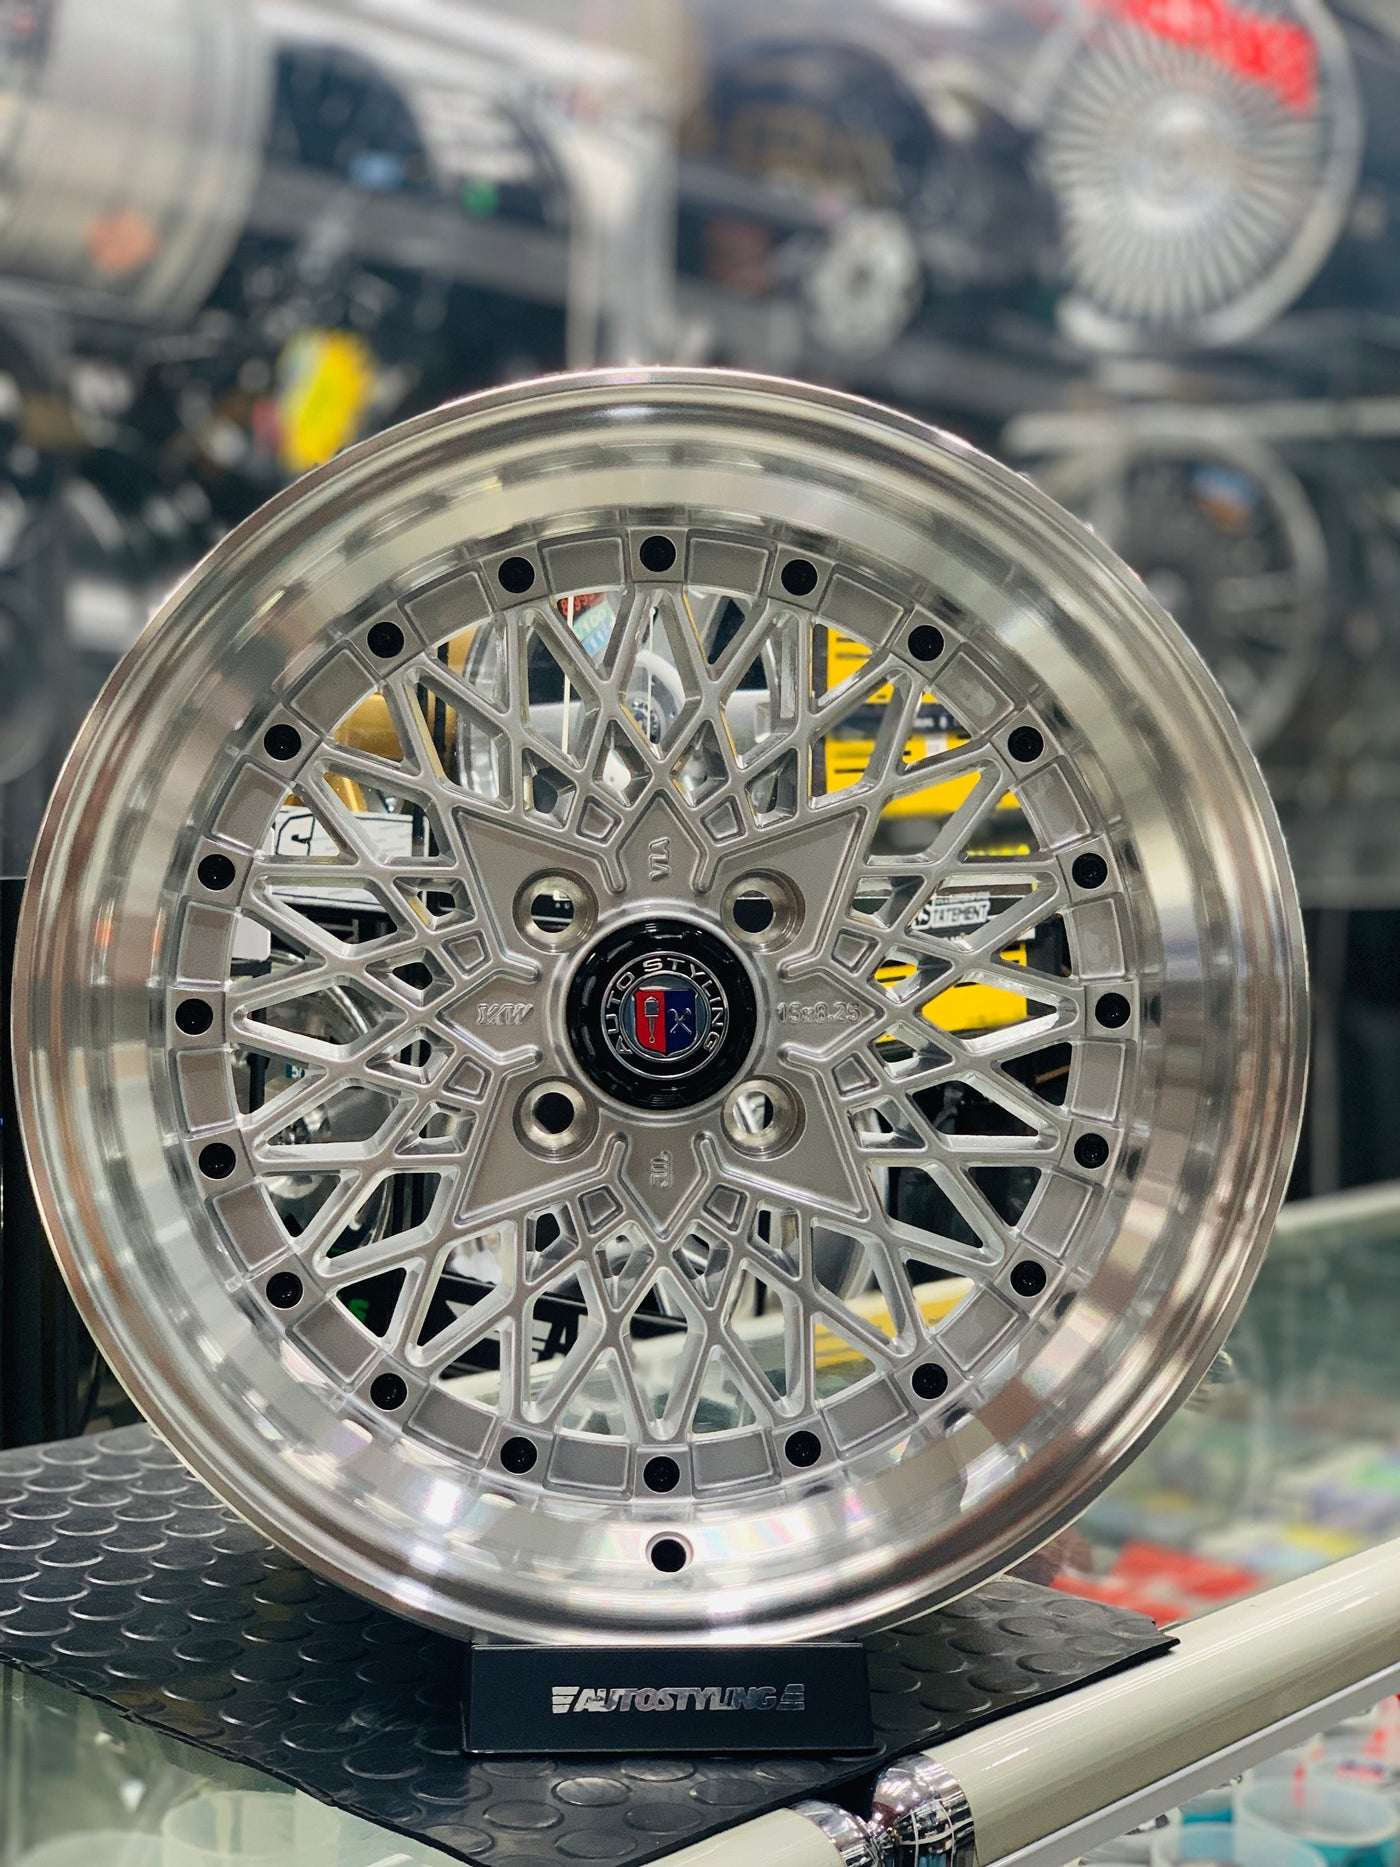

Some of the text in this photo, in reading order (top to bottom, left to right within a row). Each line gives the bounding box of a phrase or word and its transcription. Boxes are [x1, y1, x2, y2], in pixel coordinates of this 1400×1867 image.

[604, 957, 724, 1056] AUTO STYLING
[776, 1001, 861, 1023] 15x8.25
[573, 1686, 778, 1712] AUTOSTYLING
